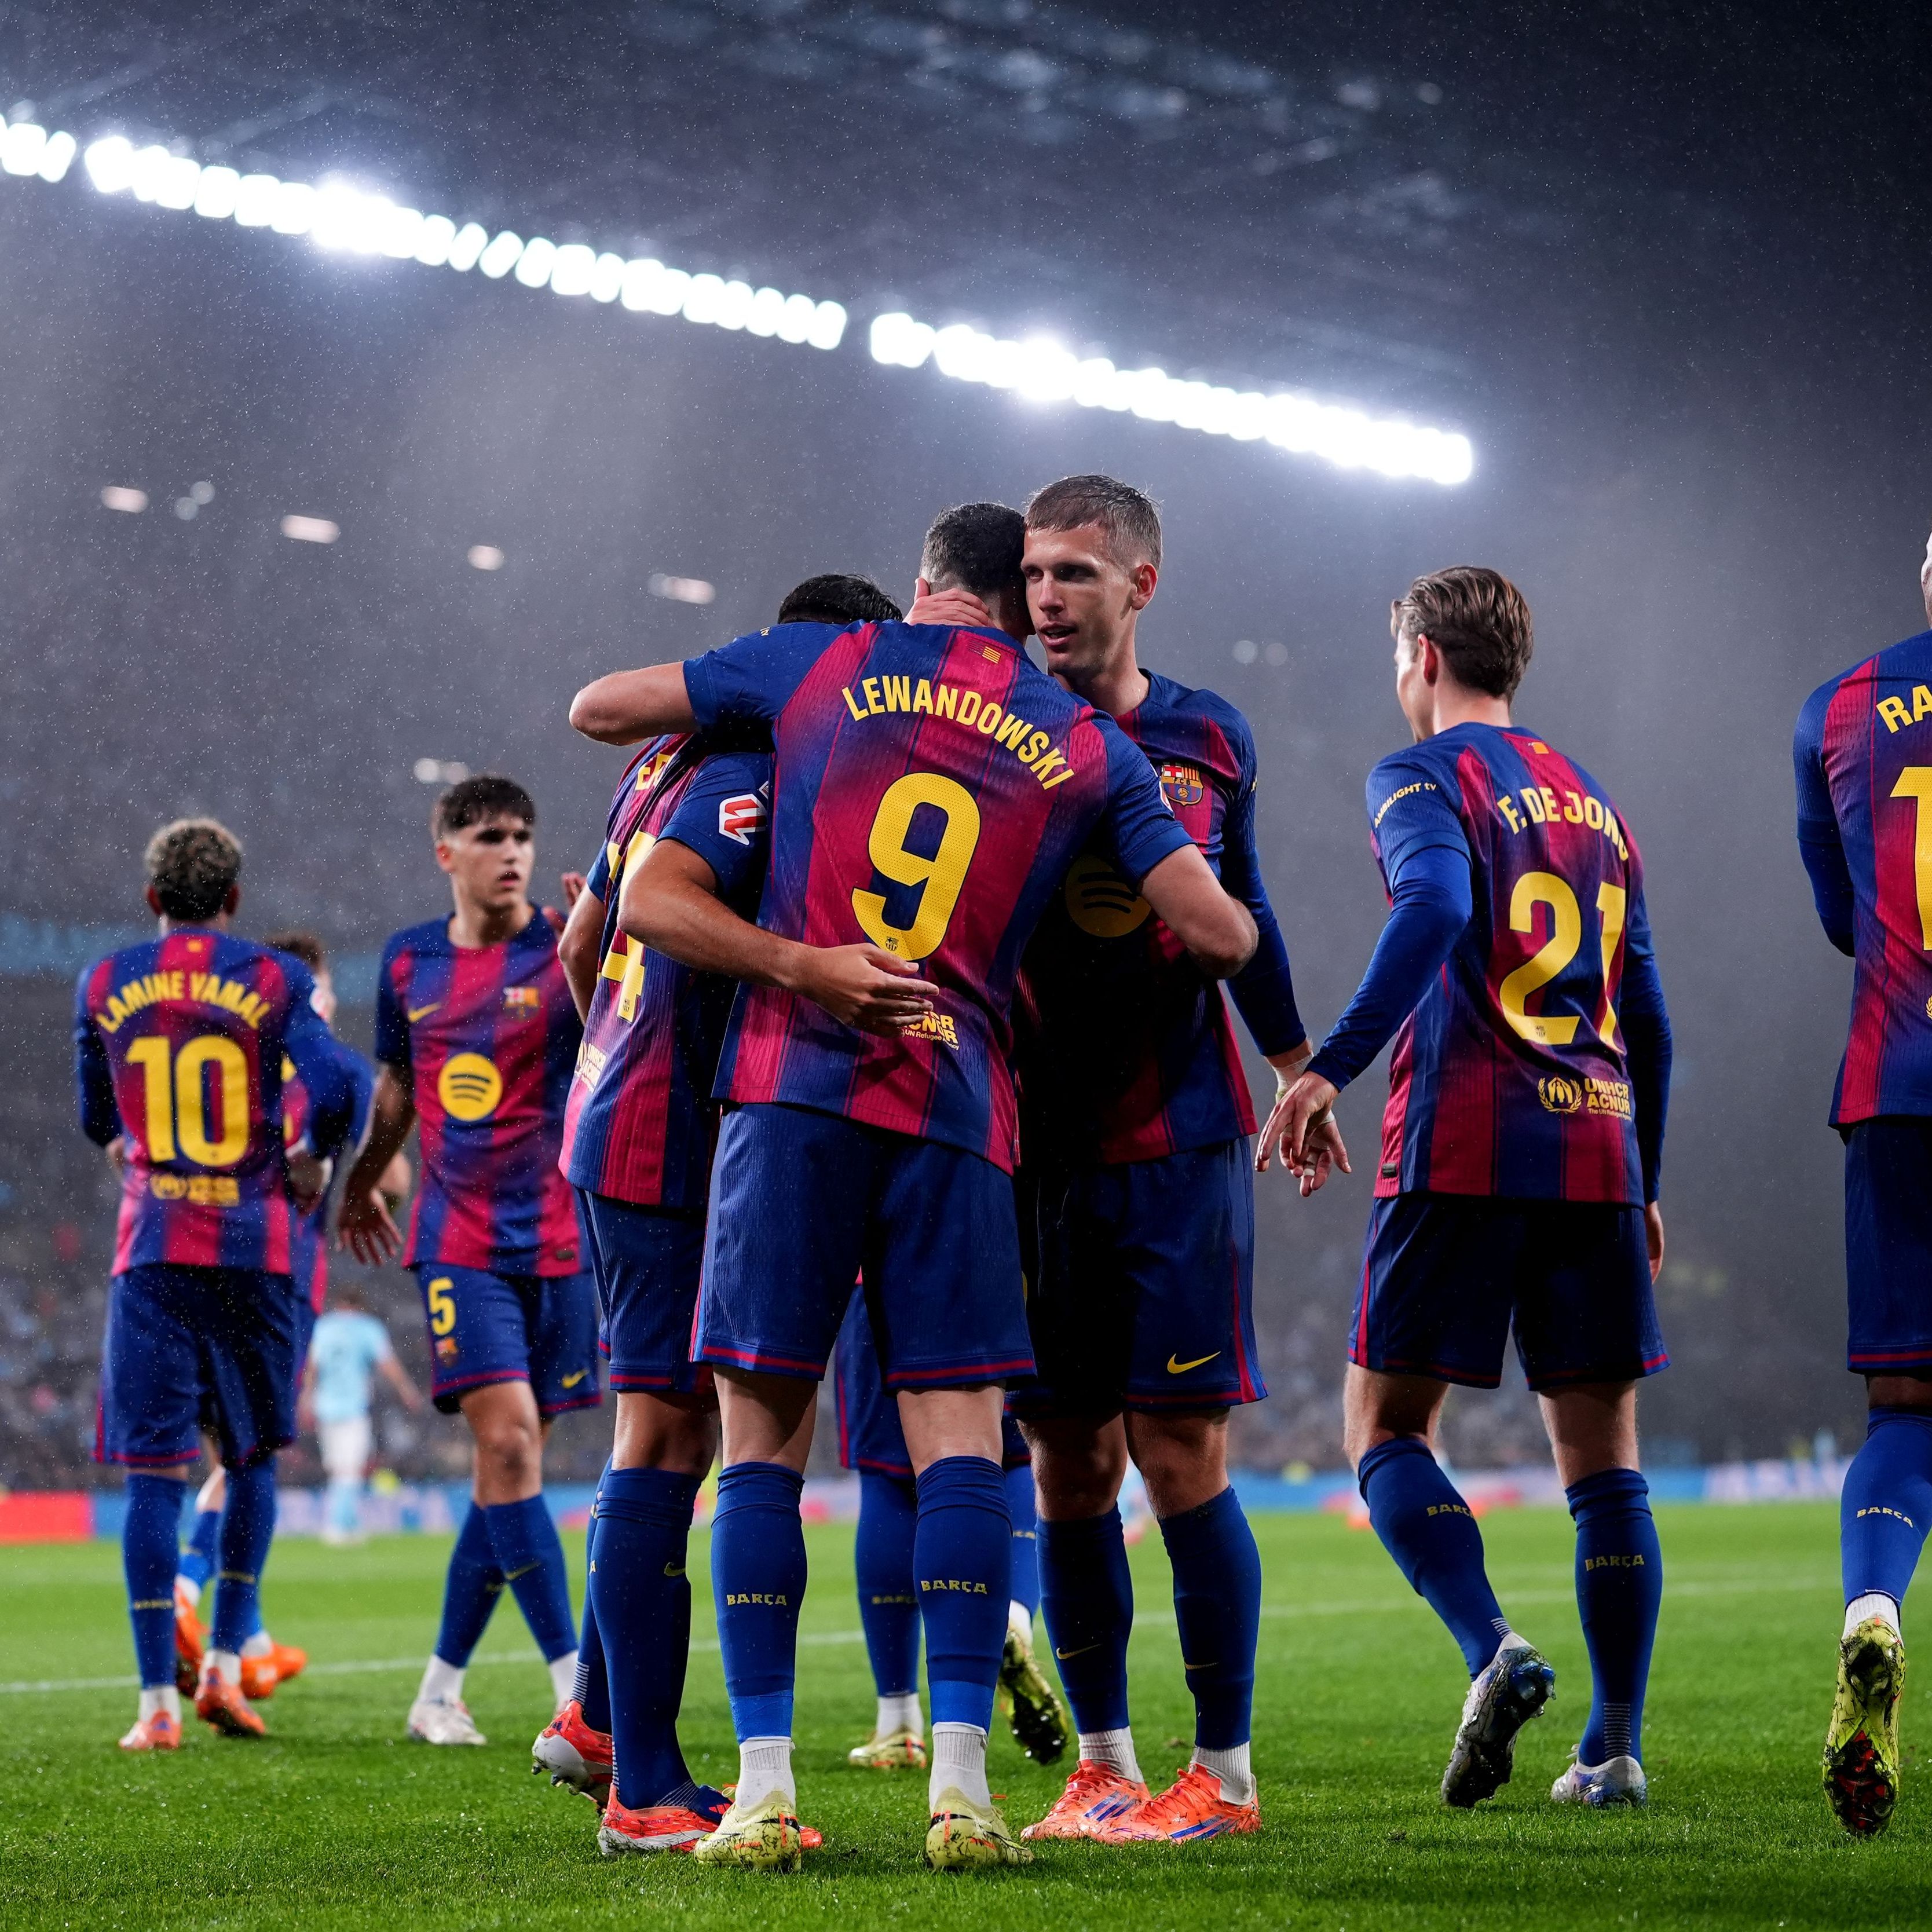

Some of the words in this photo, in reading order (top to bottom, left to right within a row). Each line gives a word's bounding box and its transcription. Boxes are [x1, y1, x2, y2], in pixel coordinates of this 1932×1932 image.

[841, 675, 1075, 790] LEWANDOWSKI
[1876, 685, 1932, 733] RA
[1497, 795, 1528, 835] F.
[1520, 786, 1561, 824] DE
[851, 772, 980, 961] 9
[1499, 871, 1626, 1055] 21
[96, 971, 185, 1034] LAMINE
[189, 972, 270, 1029] YAMAL
[916, 1031, 942, 1041] Refugee
[126, 1034, 250, 1168] 10
[1585, 1078, 1629, 1100] UNHCR
[1587, 1093, 1631, 1115] ACNUR
[428, 1276, 456, 1335] 5
[726, 1593, 787, 1606] BARÇA
[920, 1579, 987, 1594] BARÇA
